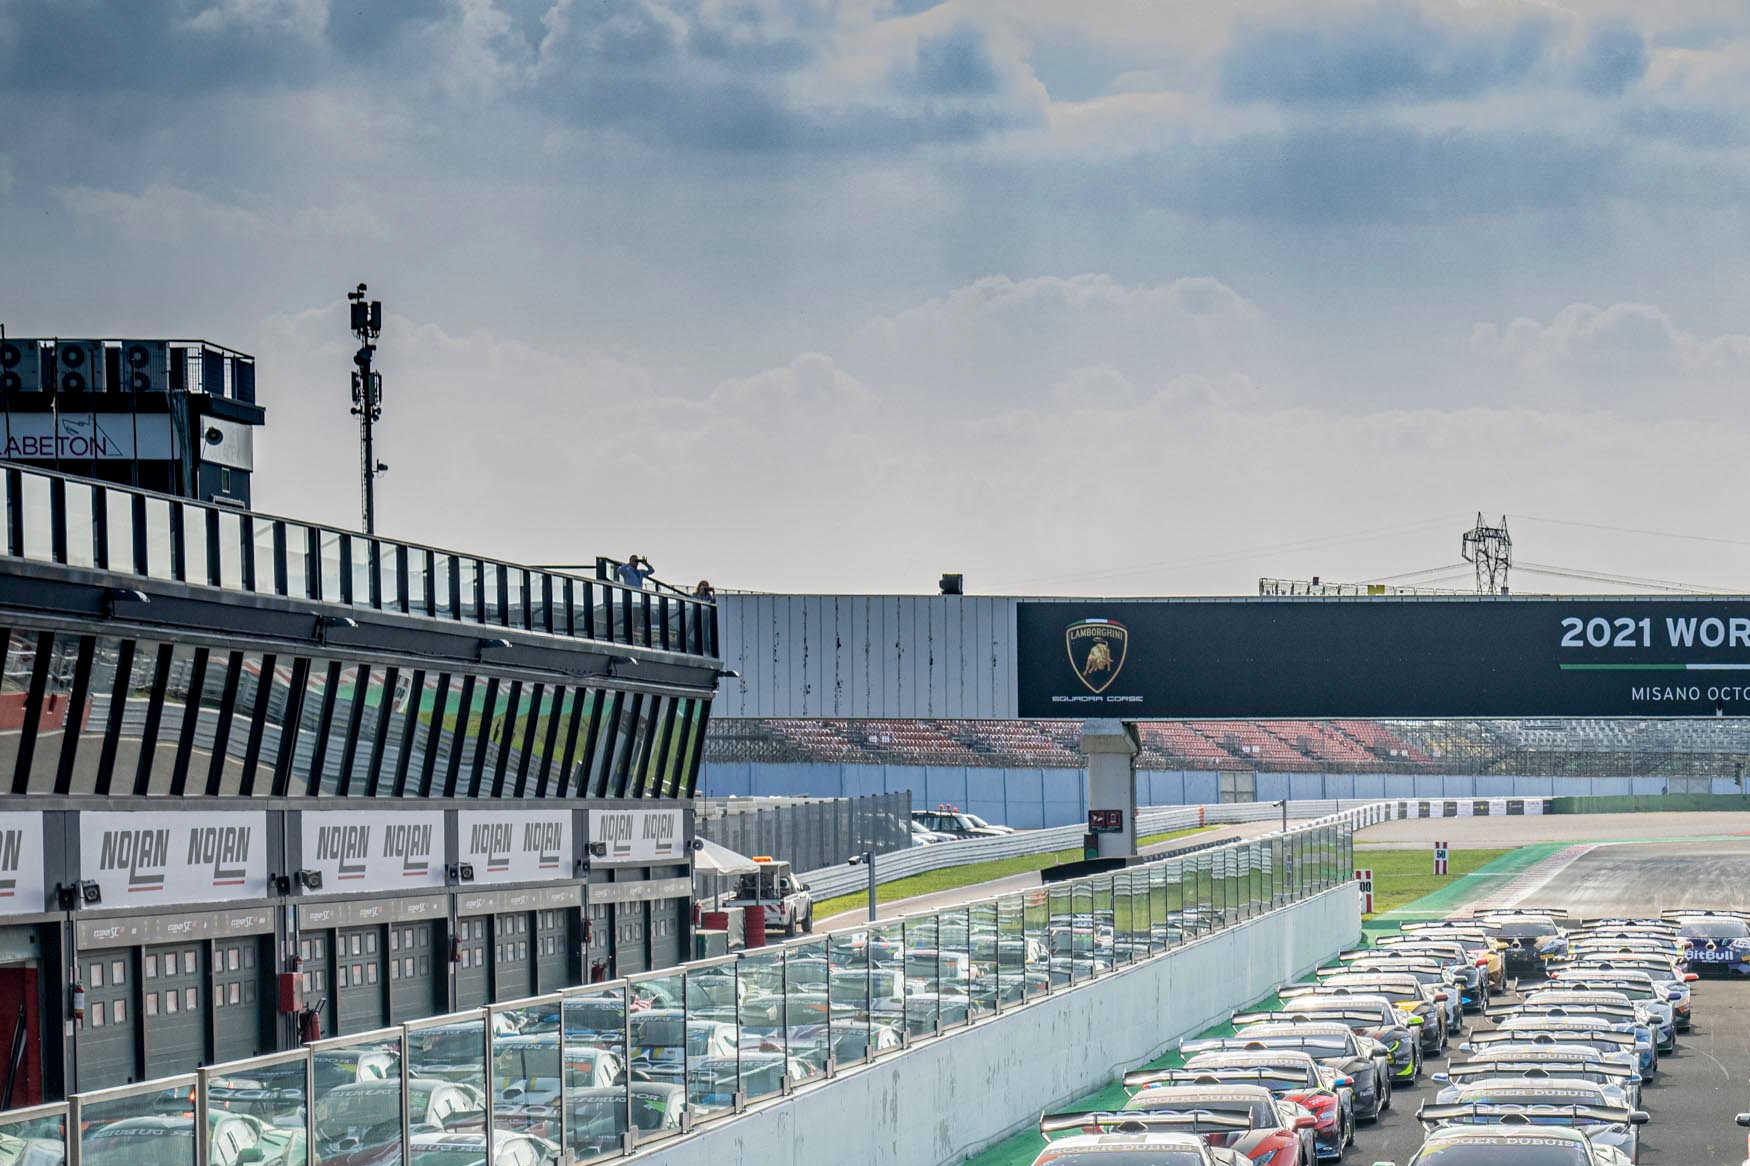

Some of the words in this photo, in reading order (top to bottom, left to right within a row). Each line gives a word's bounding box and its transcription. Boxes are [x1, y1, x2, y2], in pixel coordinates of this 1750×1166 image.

[0, 436, 107, 456] ABETON
[1070, 627, 1123, 640] LAMBORGHINI
[1560, 617, 1651, 647] 2021
[1631, 687, 1700, 701] MISANO
[600, 814, 634, 851] NOLAN
[642, 814, 675, 849] NOLAN
[316, 824, 371, 873] NOLAN
[383, 823, 432, 870] NOLAN
[470, 823, 513, 866] NOLAN
[523, 822, 563, 863] NOLAN
[100, 829, 169, 885] NOLAN
[187, 826, 251, 879] NOLAN
[1360, 881, 1372, 893] 00
[1685, 950, 1734, 961] BitBull
[1505, 1137, 1575, 1147] DUBUIS
